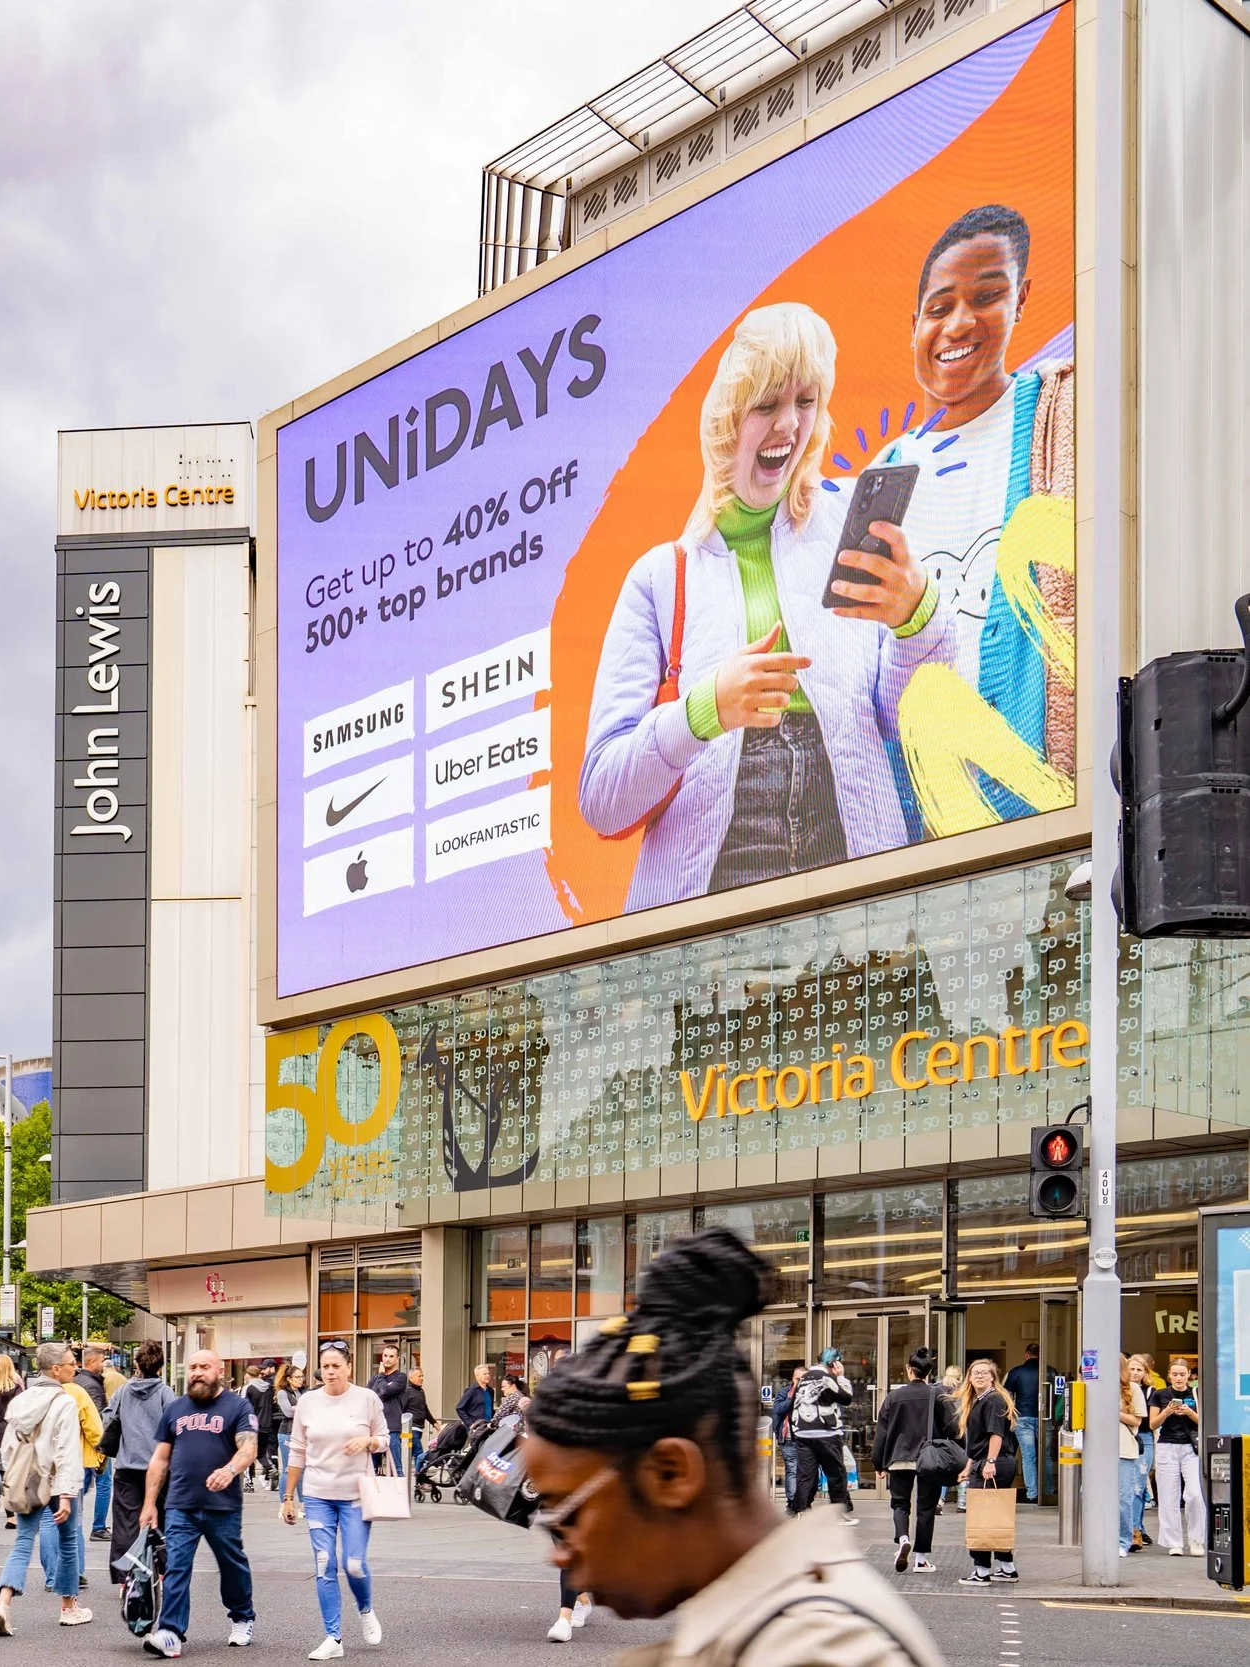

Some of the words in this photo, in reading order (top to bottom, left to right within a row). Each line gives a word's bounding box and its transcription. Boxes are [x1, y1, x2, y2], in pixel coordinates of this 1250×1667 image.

[74, 485, 157, 510] Victoria
[164, 484, 235, 507] Centre
[305, 566, 353, 609] Get
[361, 552, 395, 589] up
[404, 536, 434, 568] to
[442, 490, 509, 547] 40%
[519, 459, 578, 515] Off
[305, 605, 368, 654] 500+
[376, 583, 426, 622] top
[436, 530, 544, 601] brands
[70, 580, 121, 715] Lewis
[441, 651, 535, 709] SHEIN
[312, 702, 404, 754] SAMSUNG
[435, 753, 483, 785] Uber
[487, 736, 539, 770] Eats
[70, 727, 133, 844] John
[435, 812, 541, 857] LOOKFANTASTIC
[938, 910, 954, 927] 50
[972, 927, 988, 944] 50
[996, 922, 1013, 939] 50
[803, 940, 818, 955] 50
[989, 947, 1005, 963] 50
[938, 955, 954, 972] 50
[1049, 958, 1066, 975] 50
[604, 984, 617, 997] 50
[623, 980, 636, 993] 50
[643, 975, 656, 989] 50
[660, 970, 674, 985] 50
[681, 966, 694, 980] 50
[727, 977, 741, 992] 50
[782, 987, 797, 1002] 50
[802, 983, 817, 998] 50
[825, 979, 839, 995] 50
[847, 975, 862, 990] 50
[869, 971, 884, 987] 50
[893, 966, 908, 982] 50
[946, 976, 962, 993] 50
[972, 973, 988, 990] 50
[649, 994, 662, 1008] 50
[666, 989, 680, 1003] 50
[685, 985, 699, 999] 50
[876, 991, 891, 1007] 50
[900, 986, 916, 1003] 50
[1040, 983, 1057, 1000] 50
[987, 993, 1003, 1009] 50
[502, 1005, 514, 1018] 50
[789, 1007, 804, 1022] 50
[809, 1003, 824, 1018] 50
[831, 999, 845, 1015] 50
[1049, 1005, 1066, 1022] 50
[436, 1019, 448, 1031] 50
[643, 1015, 656, 1029] 50
[745, 1015, 760, 1030] 50
[781, 1029, 795, 1045] 50
[802, 1026, 817, 1041] 50
[825, 1022, 839, 1038] 50
[847, 1018, 862, 1034] 50
[870, 1015, 885, 1030] 50
[891, 1010, 906, 1026] 50
[473, 1029, 485, 1042] 50
[568, 1030, 581, 1043] 50
[586, 1026, 599, 1040] 50
[604, 1023, 617, 1036] 50
[687, 1026, 700, 1040] 50
[705, 1022, 719, 1037] 50
[534, 1036, 547, 1049] 50
[610, 1041, 623, 1055] 50
[648, 1033, 661, 1048] 50
[700, 1044, 713, 1058] 50
[718, 1040, 732, 1055] 50
[740, 1037, 754, 1052] 50
[876, 1035, 891, 1051] 50
[469, 1048, 481, 1061] 50
[501, 1043, 513, 1055] 50
[788, 1049, 802, 1065] 50
[809, 1046, 824, 1061] 50
[506, 1060, 518, 1073] 50
[680, 1042, 874, 1122] Victoria
[890, 1018, 1089, 1091] Centre
[745, 1056, 760, 1071] 50
[474, 1066, 487, 1078] 50
[568, 1068, 581, 1082] 50
[588, 1065, 600, 1079] 50
[667, 1070, 680, 1084] 50
[574, 1087, 587, 1100] 50
[610, 1081, 623, 1094] 50
[265, 1011, 401, 1195] 50
[407, 1097, 418, 1109] 50
[662, 1091, 675, 1105] 50
[605, 1101, 618, 1115] 50
[624, 1098, 637, 1112] 50
[502, 1117, 514, 1130] 50
[629, 1117, 642, 1131] 50
[668, 1110, 682, 1124] 50
[921, 1116, 937, 1132] 50
[575, 1126, 588, 1139] 50
[699, 1126, 713, 1140] 50
[740, 1120, 754, 1135] 50
[506, 1135, 518, 1148] 50
[787, 1134, 802, 1150] 50
[831, 1129, 845, 1144] 50
[704, 1145, 718, 1160] 50
[745, 1140, 760, 1154] 50
[327, 1149, 393, 1182] YEARS
[501, 1155, 513, 1167] 50
[668, 1151, 682, 1165] 50
[540, 1168, 552, 1181] 50
[574, 1164, 587, 1178] 50
[43, 1320, 52, 1328] 30
[176, 1412, 224, 1436] POLO
